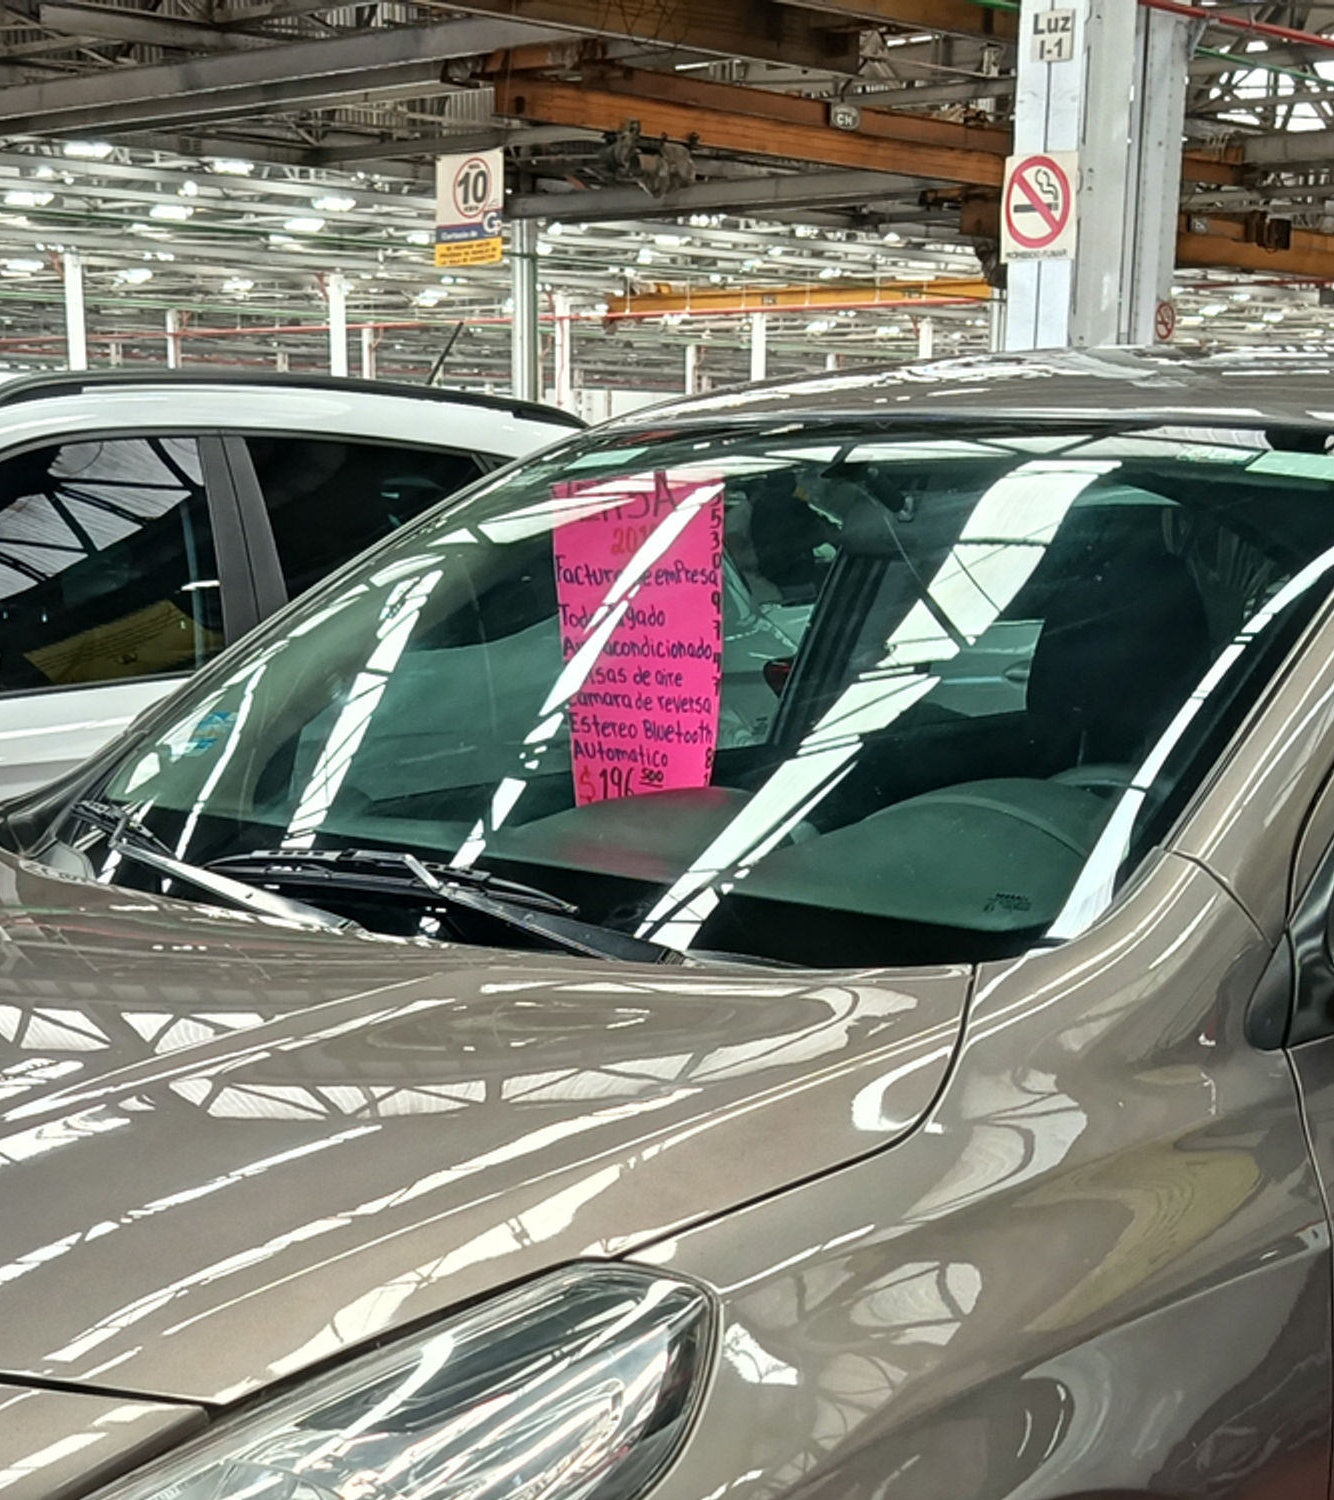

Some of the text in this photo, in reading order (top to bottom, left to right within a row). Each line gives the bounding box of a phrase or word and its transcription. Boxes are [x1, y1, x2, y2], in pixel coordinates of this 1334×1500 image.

[1032, 13, 1072, 35] Luz
[457, 170, 487, 205] 10
[610, 523, 659, 556] 201
[559, 604, 593, 629] Tod
[633, 665, 651, 687] de
[655, 668, 683, 688] aire
[635, 691, 654, 712] de
[658, 697, 712, 714] reversa
[569, 712, 638, 740] Estereo
